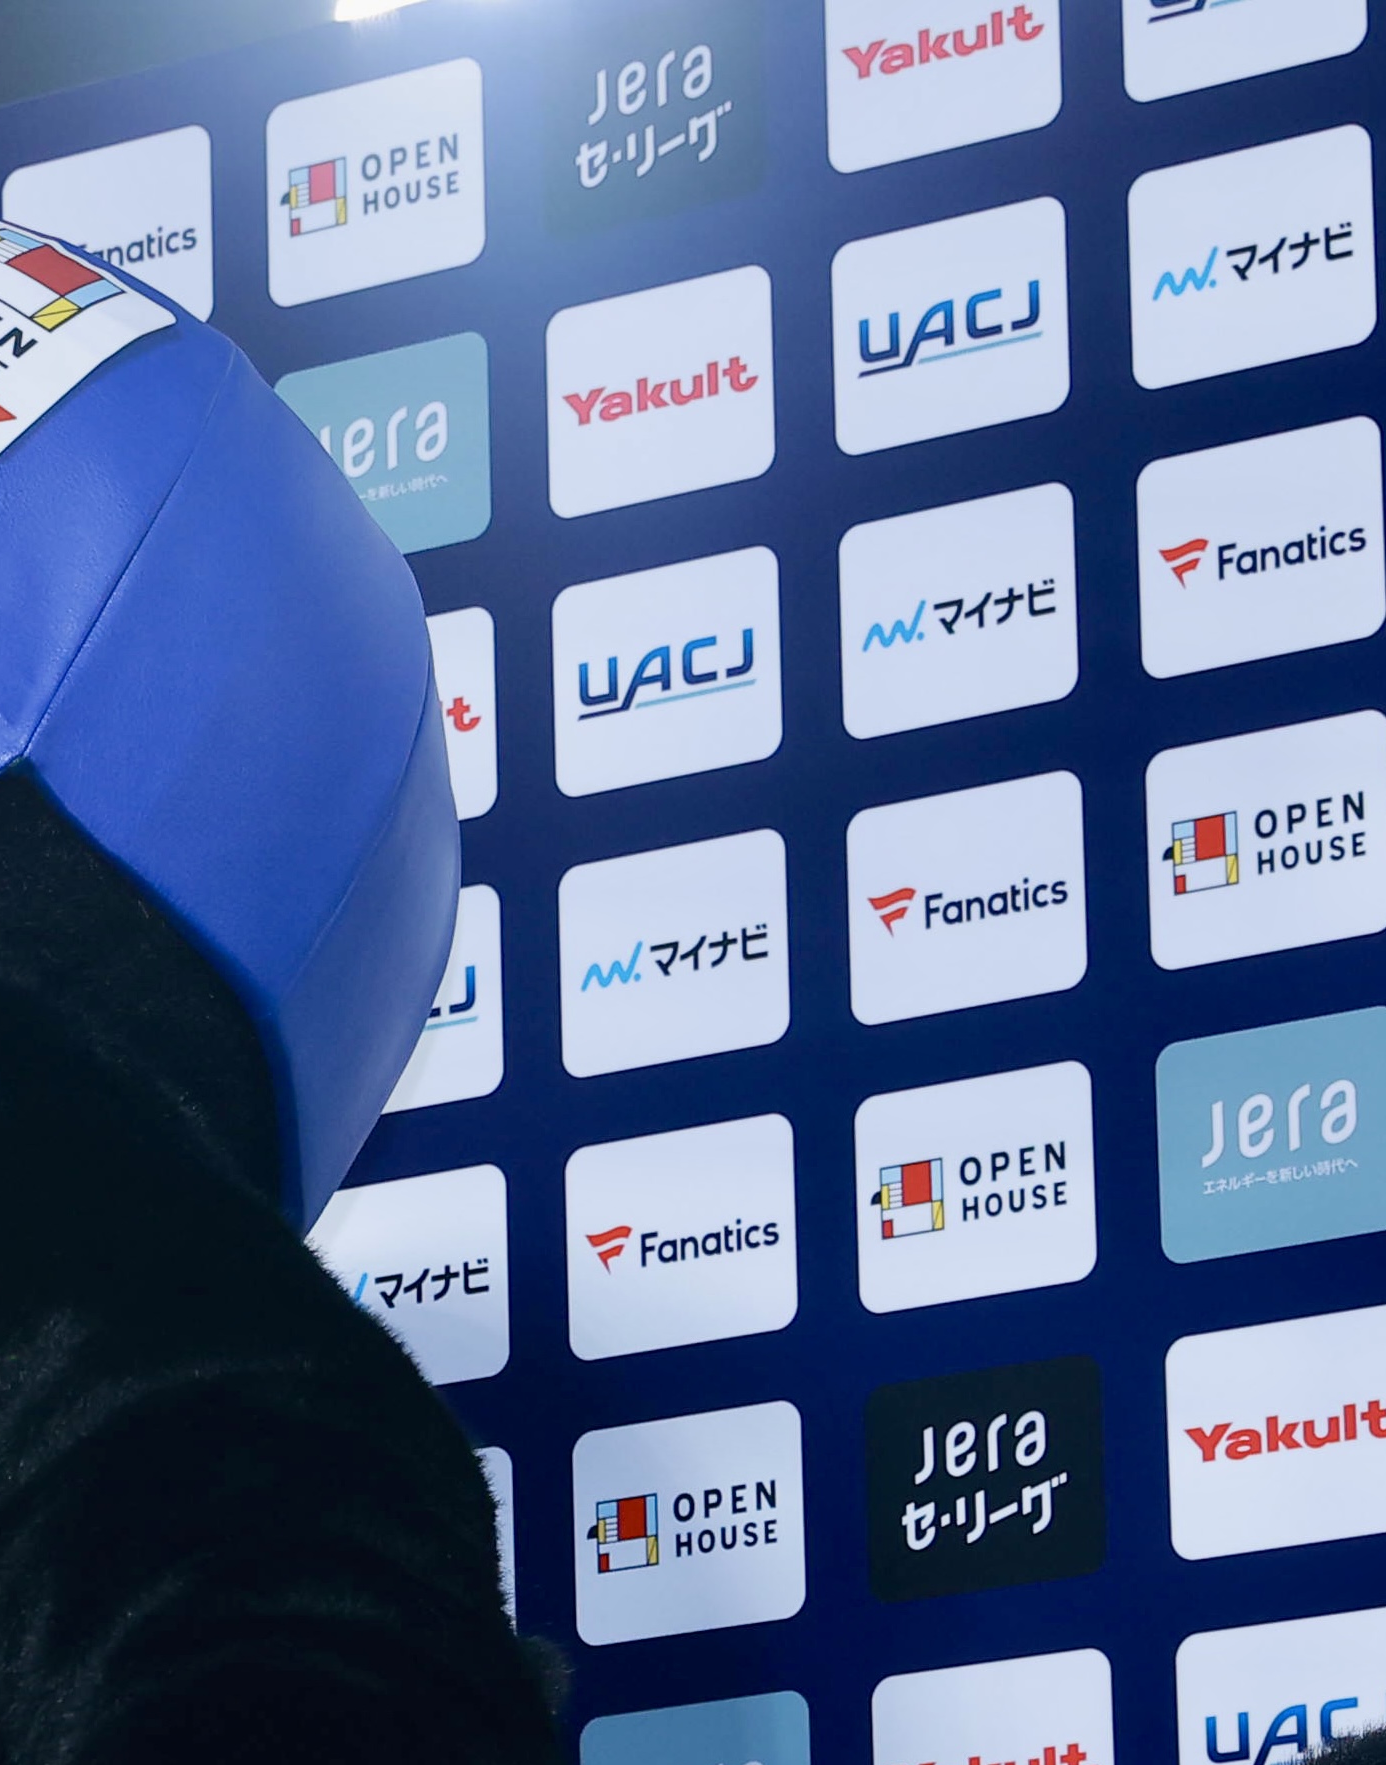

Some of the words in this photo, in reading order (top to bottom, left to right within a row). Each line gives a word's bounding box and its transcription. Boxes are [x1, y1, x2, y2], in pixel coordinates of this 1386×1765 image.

[842, 4, 1045, 80] Yakult
[361, 134, 459, 182] OPEN
[361, 170, 460, 216] HOUSE
[1226, 221, 1354, 282] マイナビ
[858, 279, 1041, 379] UACJ
[562, 355, 759, 426] Yakult
[1217, 526, 1367, 581] Fanatics
[933, 579, 1056, 636] マイナビ
[578, 627, 755, 721] UACJ
[1254, 790, 1366, 839] OPEN
[1256, 832, 1367, 875] HOUSE
[924, 877, 1069, 930] Fanatics
[649, 923, 769, 977] マイナビ
[959, 1140, 1067, 1187] OPEN
[961, 1181, 1068, 1222] HOUSE
[640, 1218, 780, 1268] Fanatics
[374, 1257, 490, 1309] マイナビ
[1184, 1399, 1386, 1463] Yakult
[672, 1479, 777, 1523] OPEN
[901, 1471, 1068, 1551] セ・リーグ
[674, 1519, 778, 1558] HOUSE
